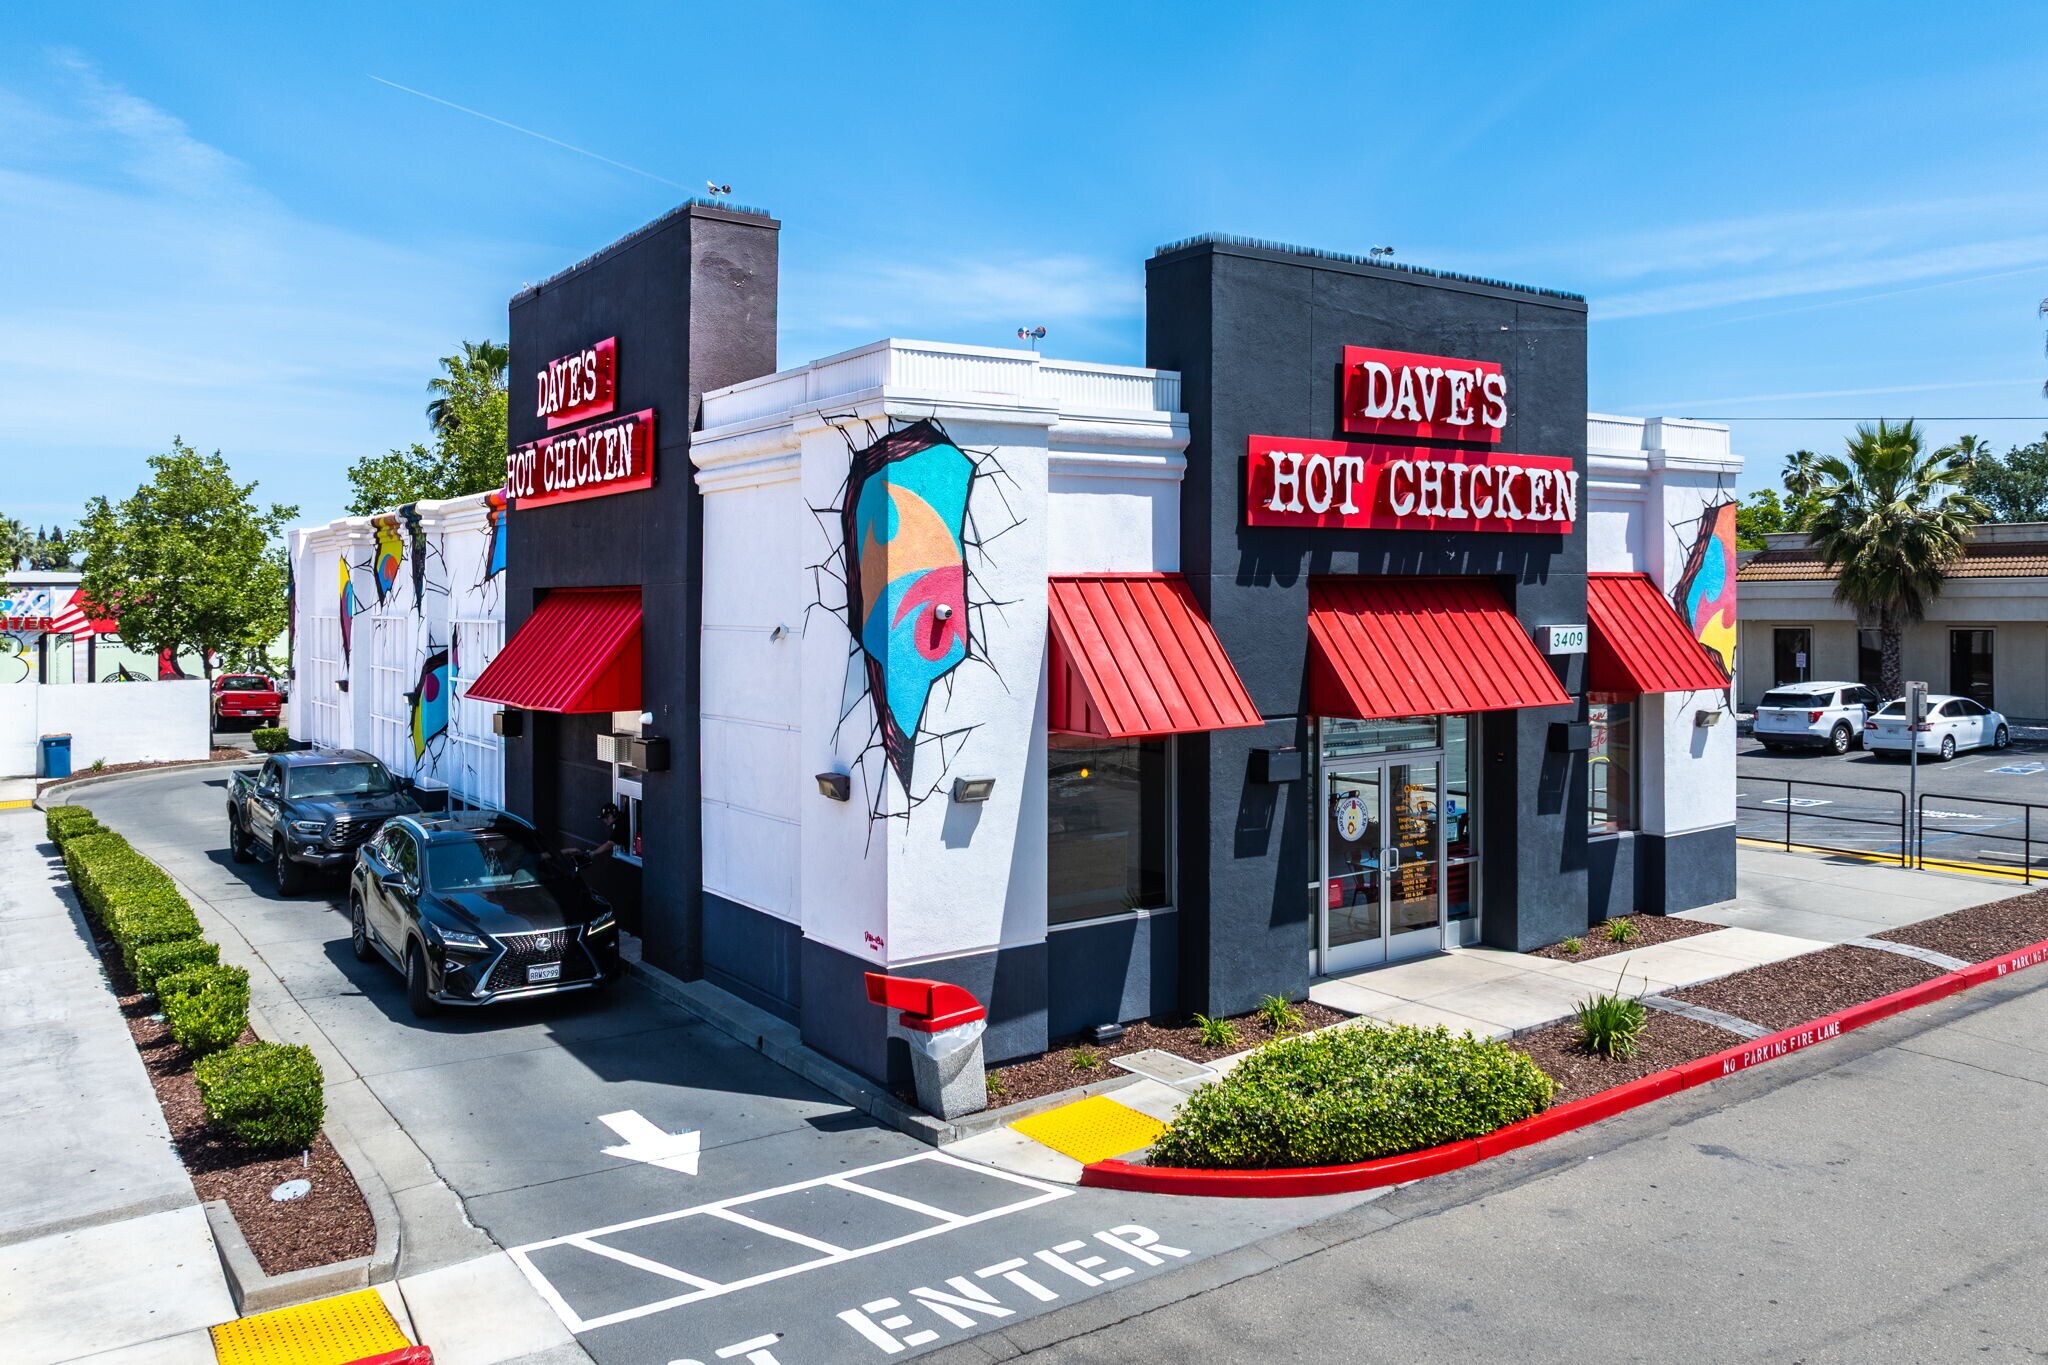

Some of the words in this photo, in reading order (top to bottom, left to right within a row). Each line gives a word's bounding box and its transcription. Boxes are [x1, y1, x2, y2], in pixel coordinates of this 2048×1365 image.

[537, 350, 597, 417] DAVE'S
[1362, 360, 1508, 429] DAVE'S
[506, 449, 537, 499] HOT
[543, 422, 634, 492] CHICKEN
[1268, 450, 1364, 515] HOT
[1389, 459, 1580, 522] CHICKEN
[1554, 631, 1583, 648] 3409
[1997, 963, 2007, 976] NO
[2011, 951, 2042, 971] PARKING
[1723, 1058, 1736, 1075] NO
[1744, 1039, 1787, 1067] PARKING
[1790, 1031, 1814, 1049] FIRE
[1817, 1021, 1841, 1041] LANE
[836, 1224, 1192, 1355] ENTER
